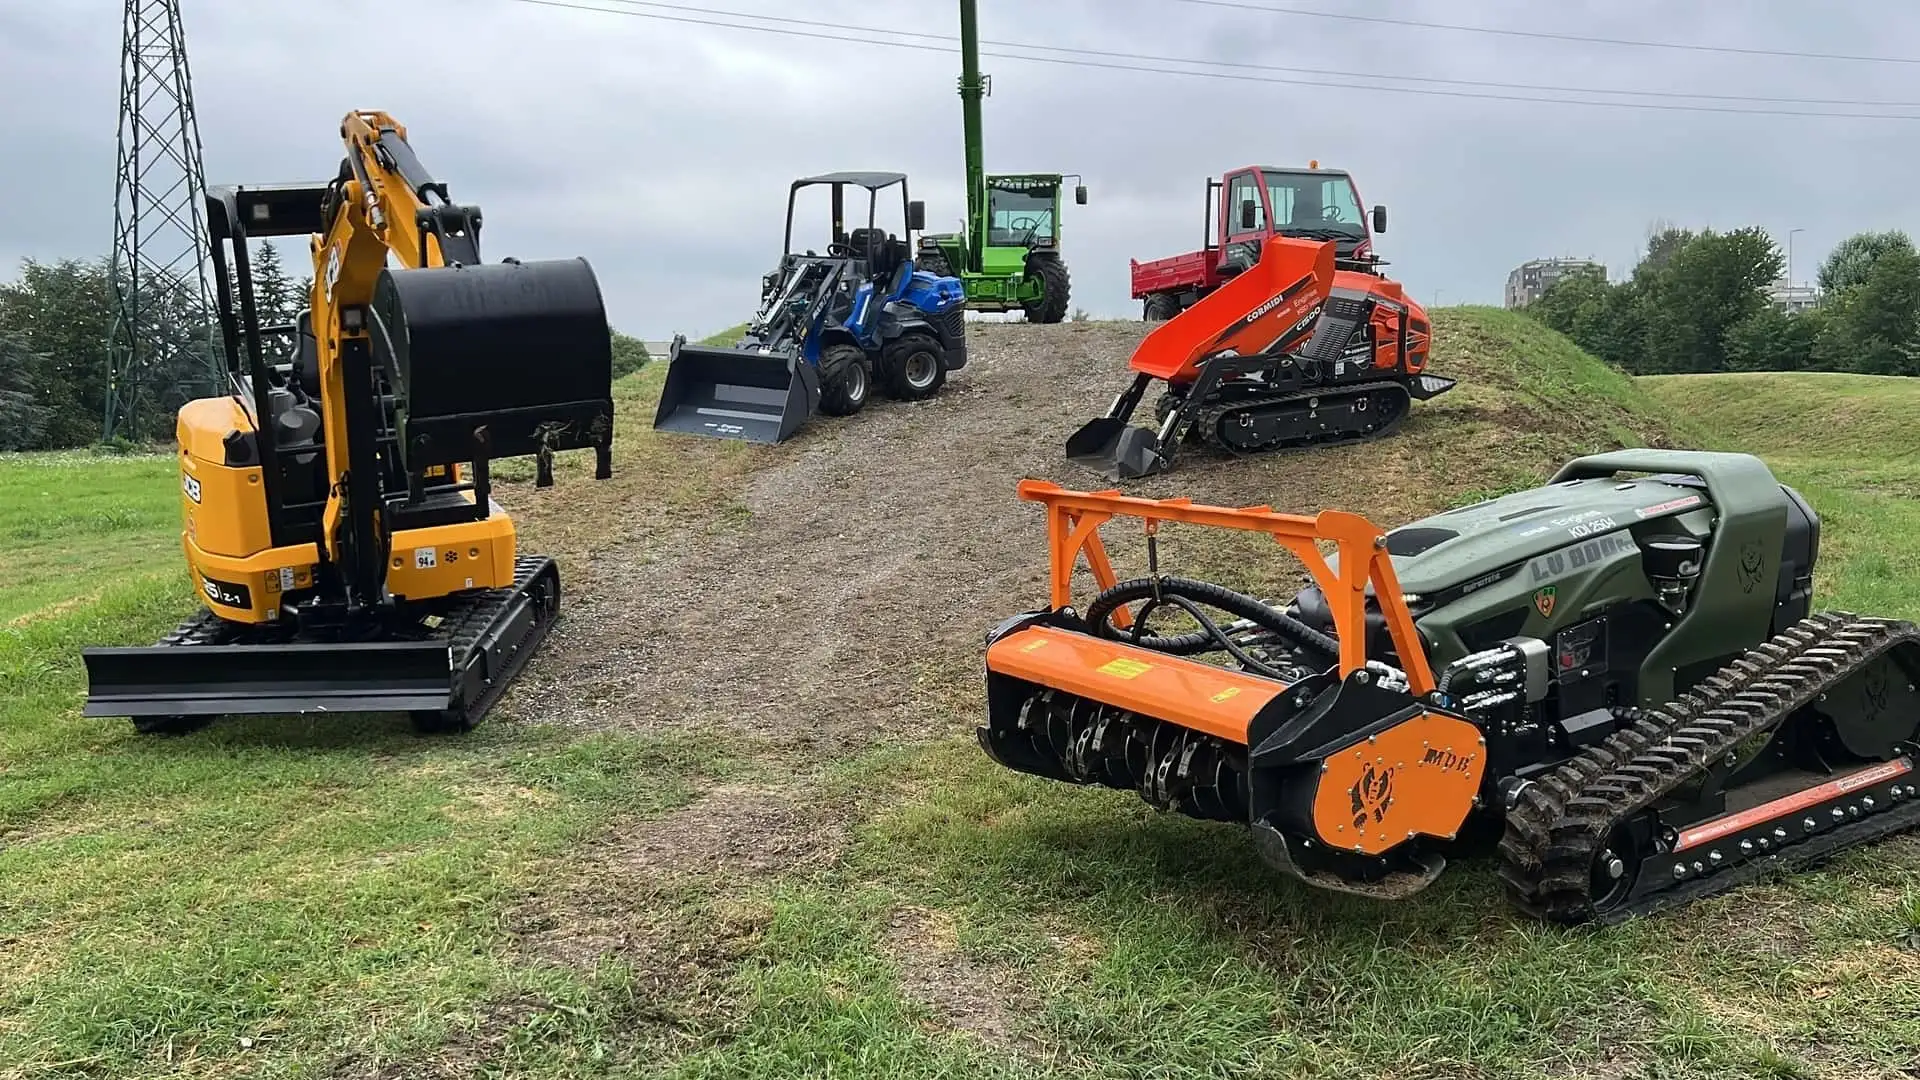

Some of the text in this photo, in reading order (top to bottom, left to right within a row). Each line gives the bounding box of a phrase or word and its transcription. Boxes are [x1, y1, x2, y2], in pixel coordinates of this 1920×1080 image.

[1246, 294, 1284, 323] CORMIDI
[184, 473, 201, 501] CB
[1567, 523, 1592, 539] KDI
[1423, 748, 1470, 772] MDB
